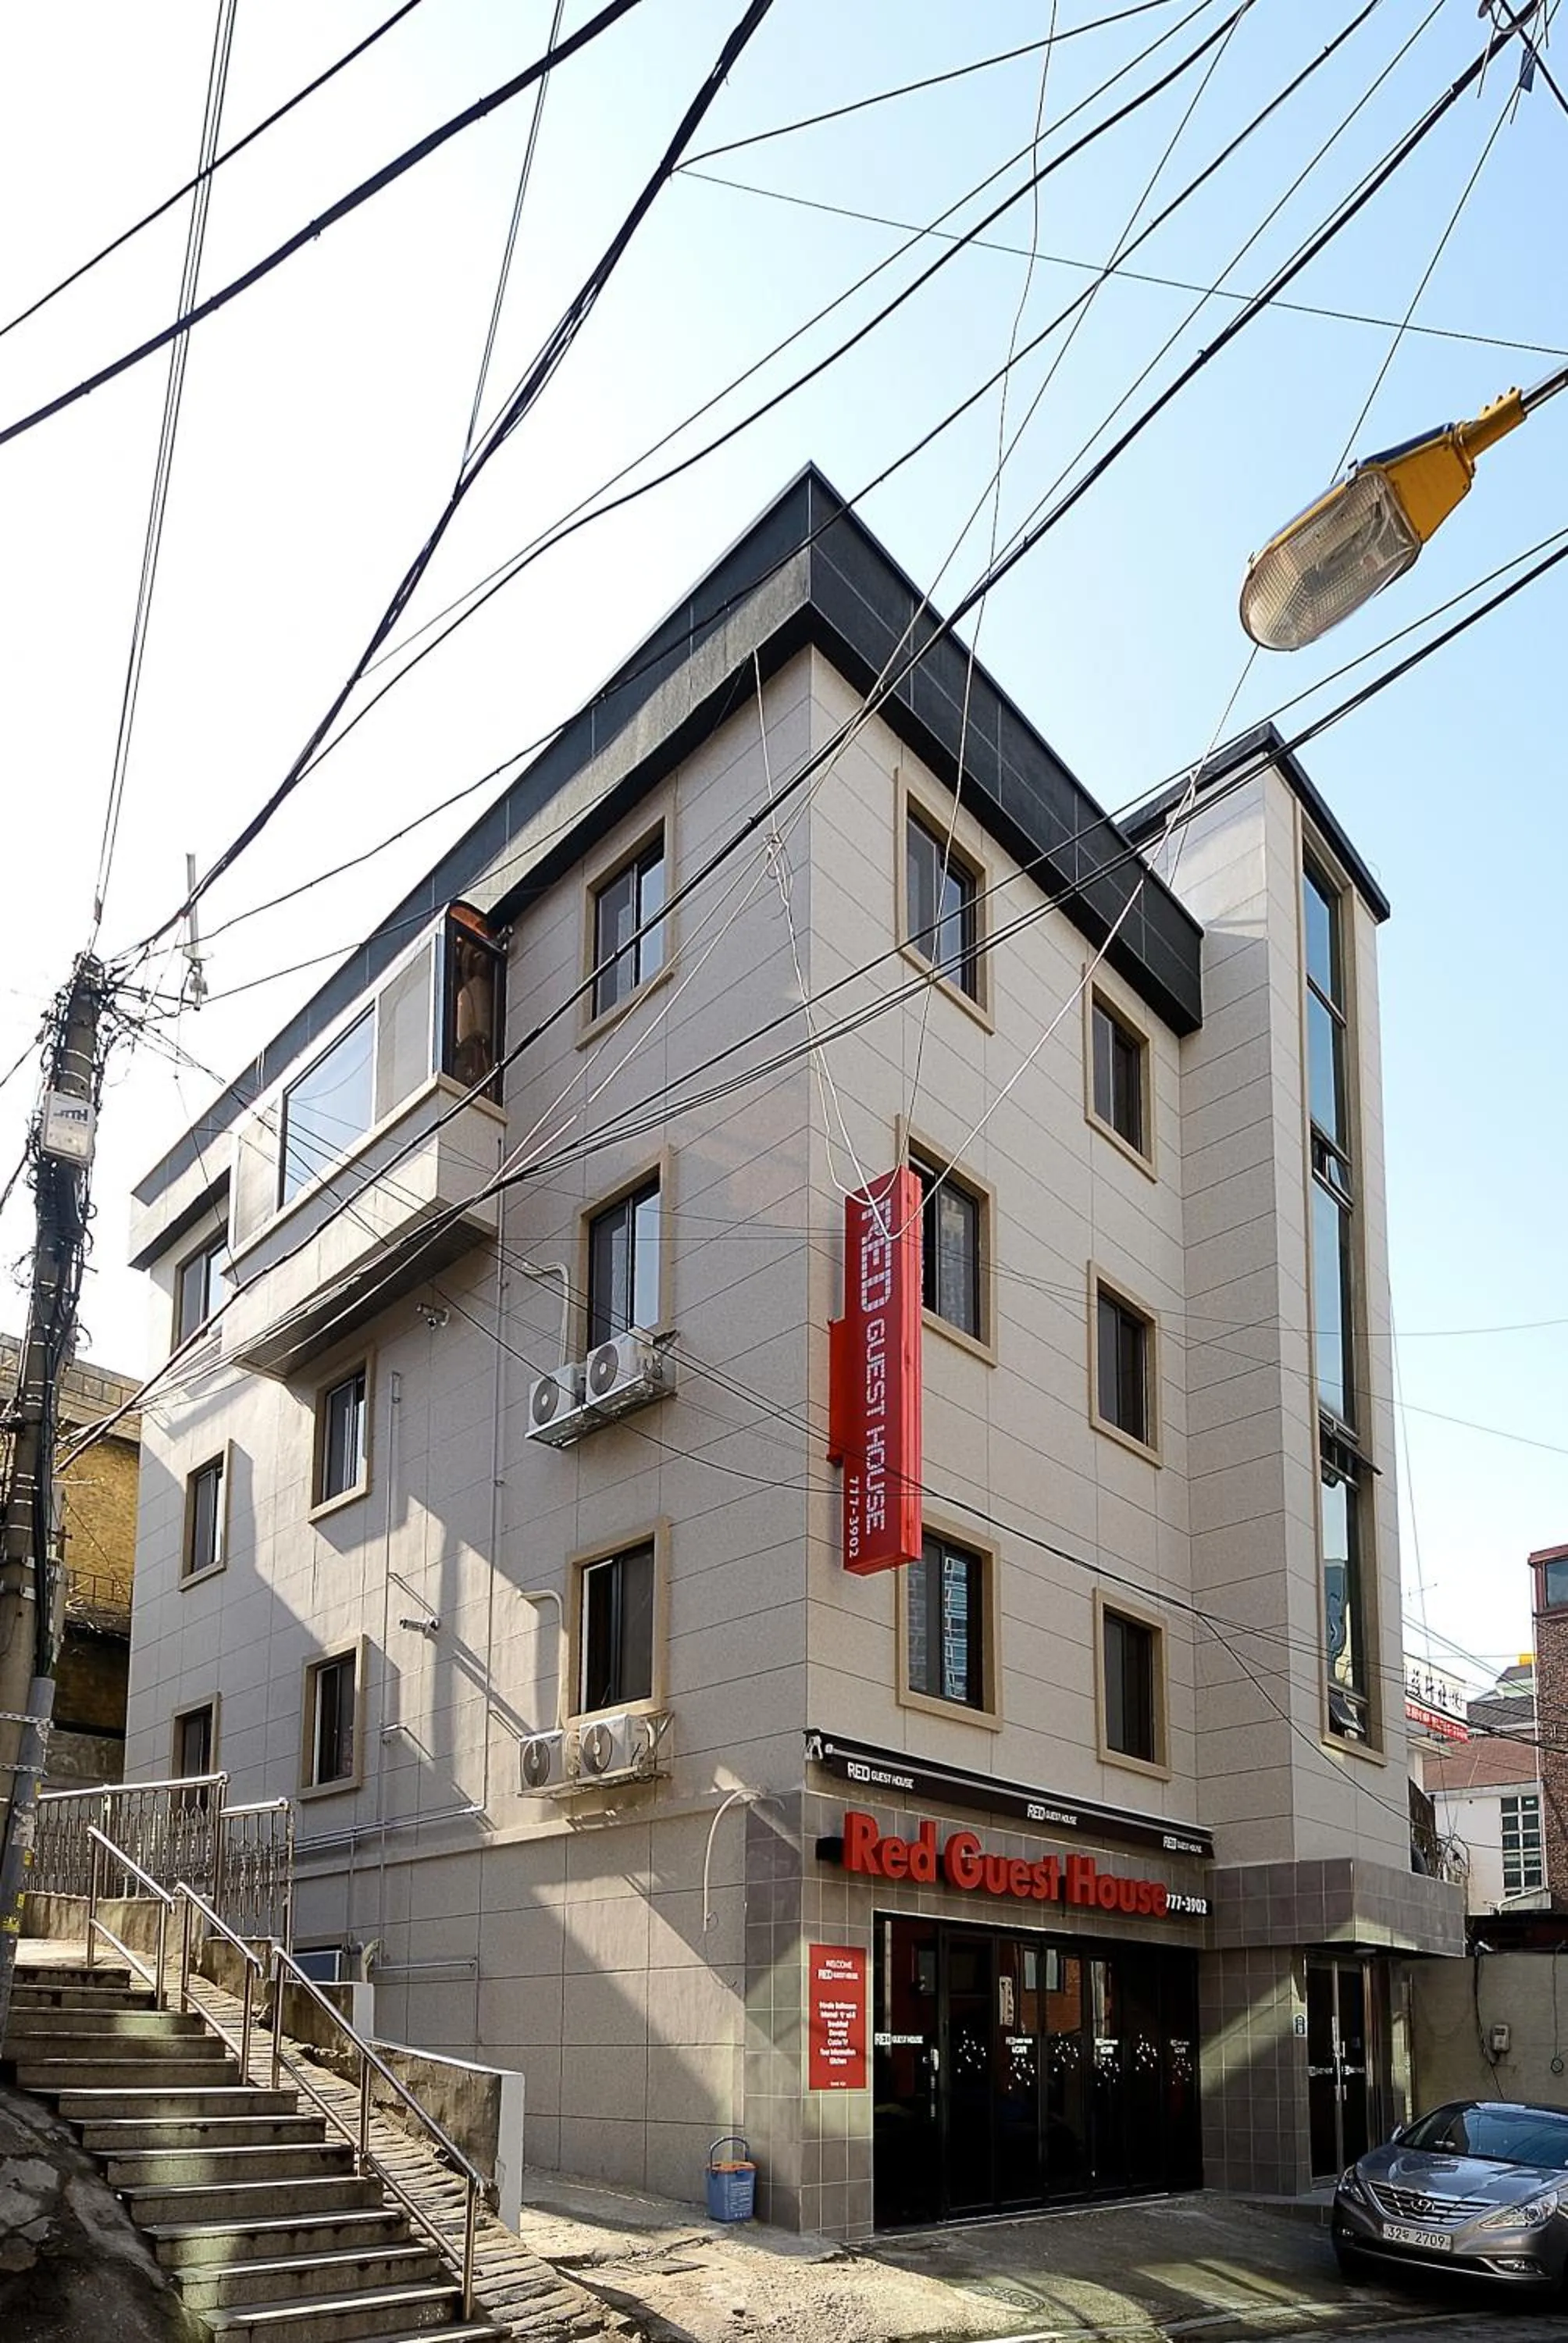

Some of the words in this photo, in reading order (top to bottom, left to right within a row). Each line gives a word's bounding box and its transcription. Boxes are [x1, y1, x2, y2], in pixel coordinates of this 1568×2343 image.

[861, 1198, 892, 1313] RED
[866, 1318, 885, 1417] GUEST
[849, 1475, 860, 1558] 777-3902
[866, 1425, 885, 1535] HOUSE
[847, 1762, 871, 1781] RED
[871, 1771, 892, 1784] GUEST
[892, 1774, 914, 1789] HOUSE
[1027, 1803, 1046, 1821] RED
[843, 1811, 936, 1885] Red
[944, 1831, 1061, 1901] Guest
[1066, 1854, 1169, 1920] House
[1166, 1892, 1207, 1914] 777-3902
[1415, 2231, 1445, 2248] 2709
